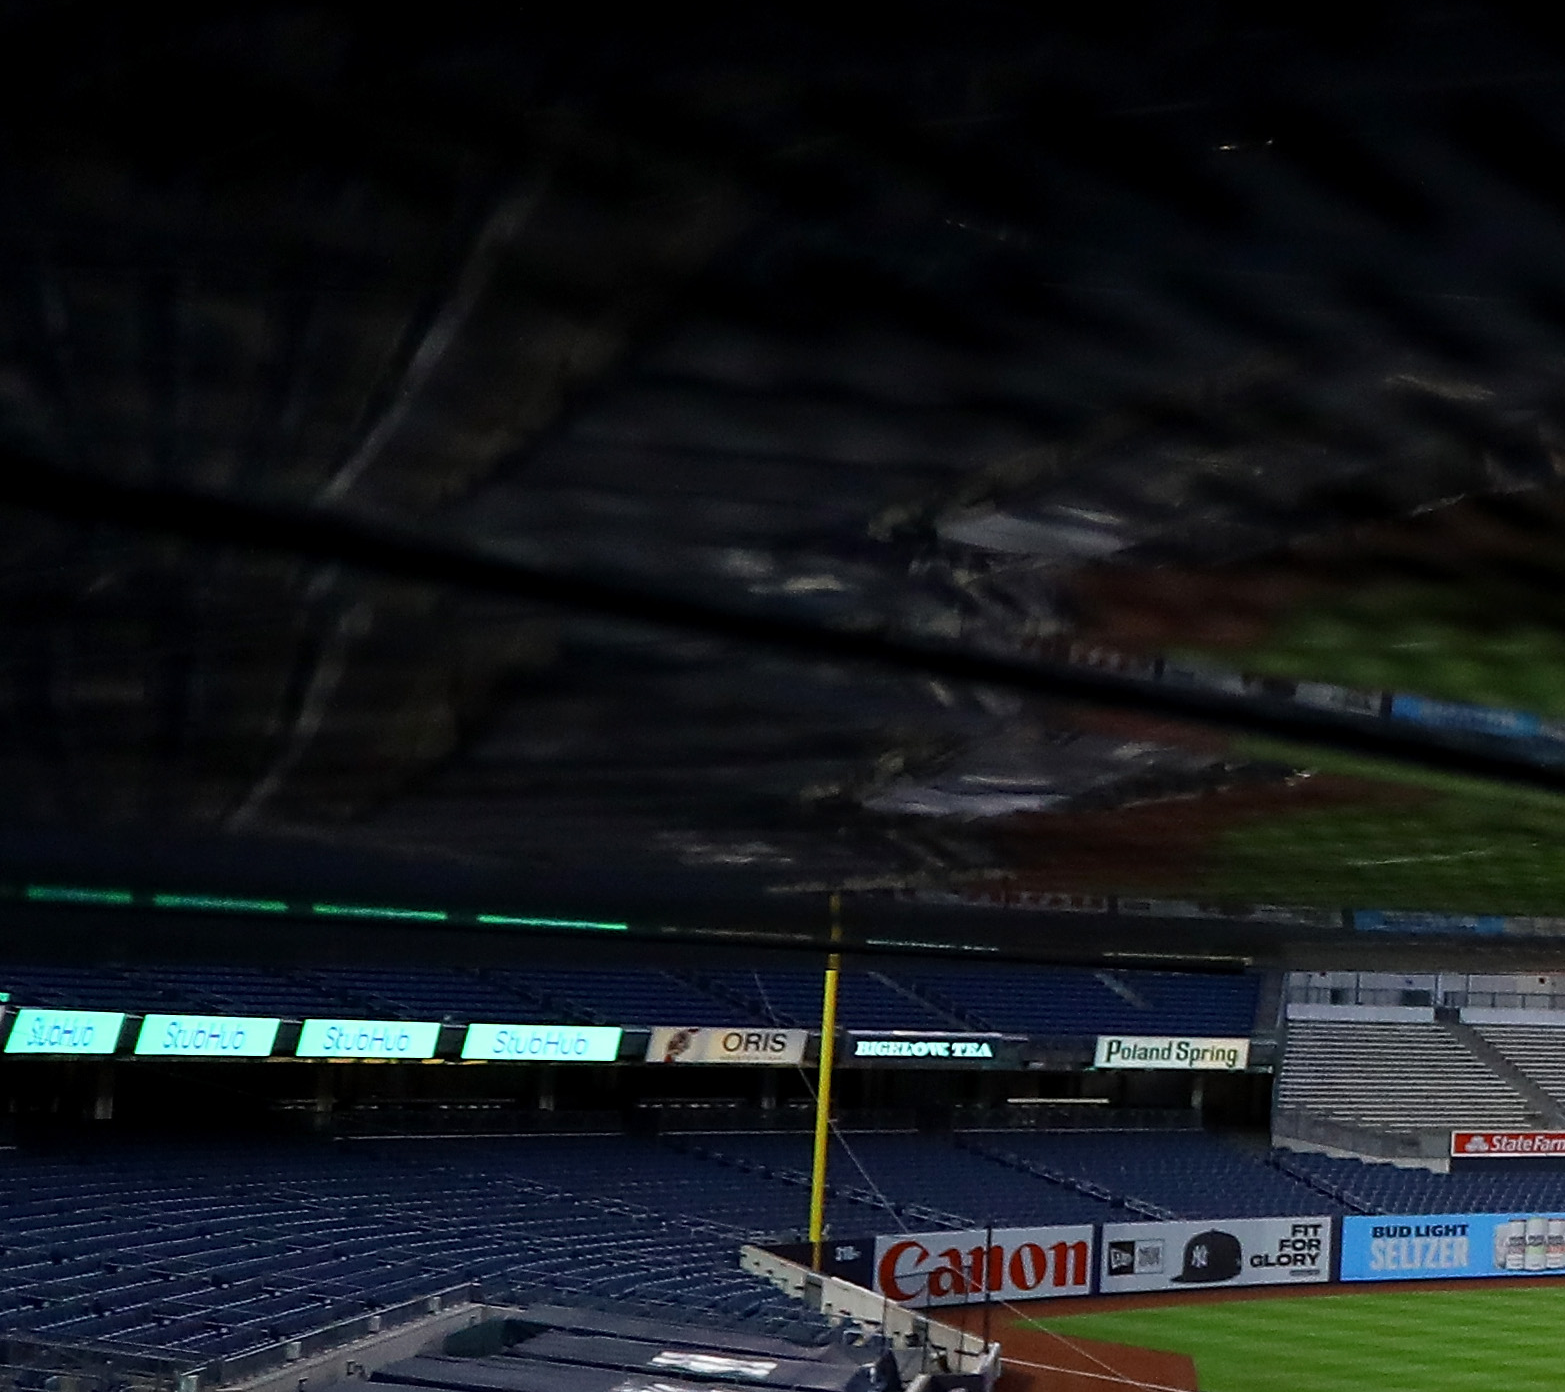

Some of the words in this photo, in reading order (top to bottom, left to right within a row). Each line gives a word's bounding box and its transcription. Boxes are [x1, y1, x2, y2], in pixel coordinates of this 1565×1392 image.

[163, 1021, 246, 1051] StubHub
[323, 1025, 410, 1052] StubHub
[492, 1029, 589, 1058] StubHub
[722, 1031, 787, 1053] ORIS
[854, 1040, 951, 1057] BIGELOW
[953, 1041, 994, 1058] TEA
[1106, 1039, 1173, 1063] Poland
[1175, 1040, 1239, 1067] Spring
[1291, 1223, 1323, 1238] FIT
[1371, 1225, 1413, 1239] BUD
[1415, 1223, 1469, 1237] LIGHT
[1278, 1238, 1322, 1252] FOR
[1370, 1236, 1469, 1271] SELTZER
[878, 1240, 1089, 1302] Canon
[1249, 1252, 1319, 1268] GLORY
